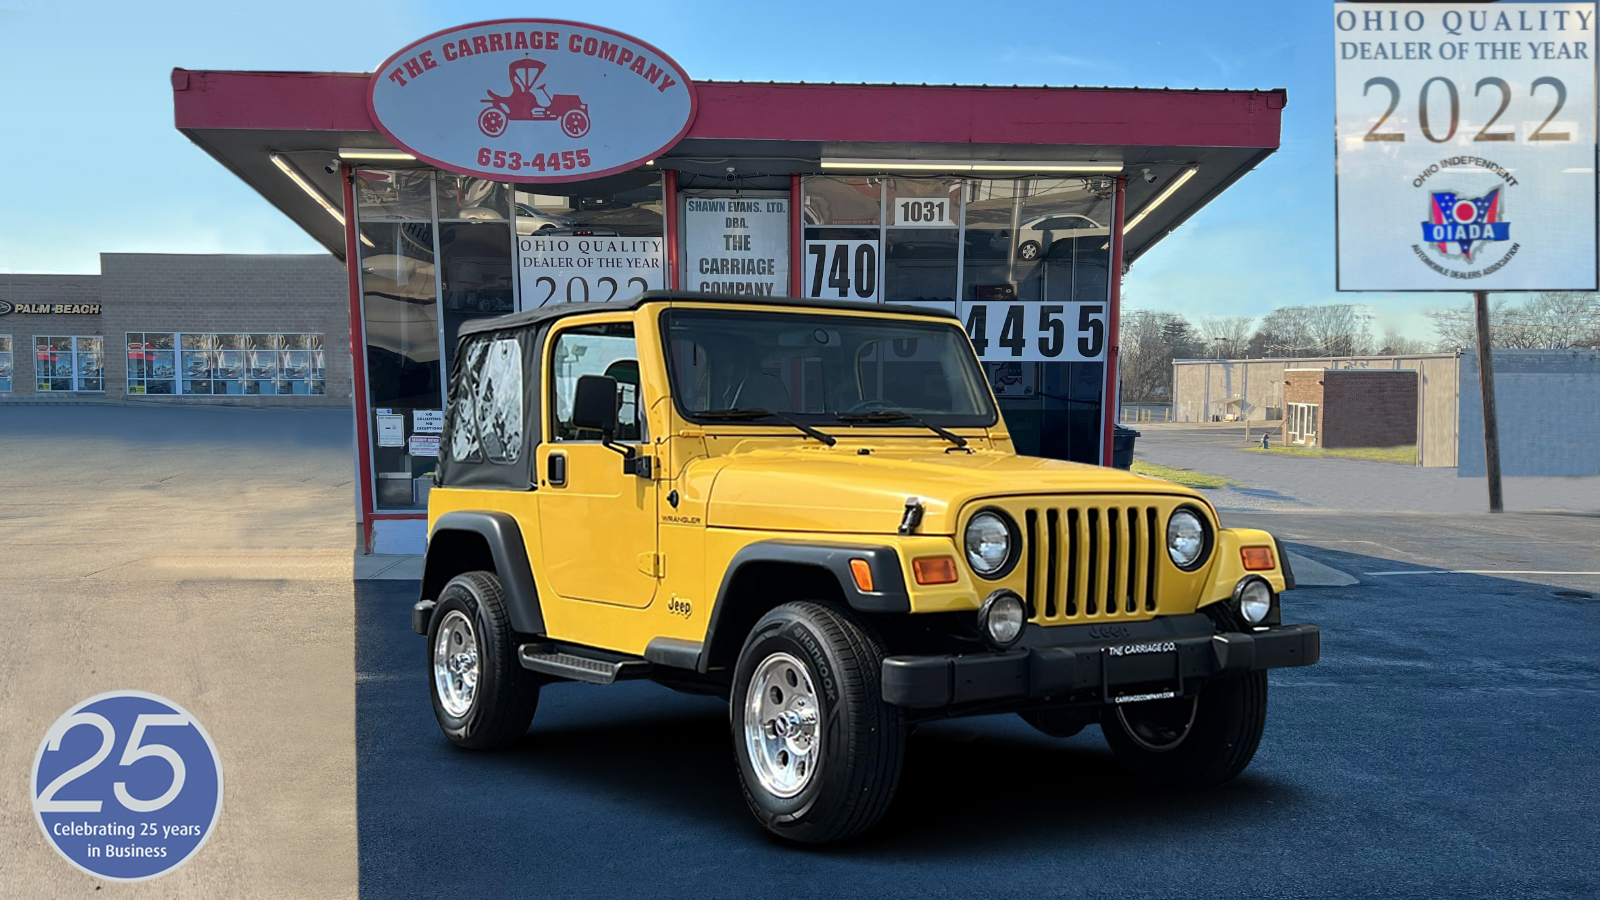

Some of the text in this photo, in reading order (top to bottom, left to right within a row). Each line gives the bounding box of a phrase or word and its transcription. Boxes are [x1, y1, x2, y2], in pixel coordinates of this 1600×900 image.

[1336, 10, 1593, 36] OHIO QUALITY
[1340, 41, 1589, 60] DEALER OF THE YEAR
[388, 31, 677, 94] THE CARRIAGE COMPANY
[1362, 76, 1571, 143] 2022
[477, 148, 592, 172] 653-4455
[1412, 155, 1519, 189] OHIO INDEPENDENT
[688, 201, 786, 213] SHAWN EVANS. LTD.
[901, 201, 945, 223] 1031
[725, 217, 749, 229] DBA.
[1433, 223, 1495, 241] OIADA
[520, 240, 662, 255] OHIO QUALITY
[723, 234, 751, 252] THE
[523, 256, 660, 269] DEALER OF THE YEAR
[699, 257, 775, 276] CARRIAGE
[1410, 241, 1521, 280] AUTOMOBILE DEALERS ASSOCIATION
[808, 243, 876, 299] 740
[700, 281, 774, 297] COMPANY
[15, 303, 100, 314] PALM BEACH
[963, 304, 1104, 359] 4455
[661, 515, 702, 524] WRANGLER
[668, 597, 691, 615] Jeep
[1088, 626, 1130, 639] Jeep
[1109, 641, 1177, 656] THE CARRIAGE CO.
[799, 632, 836, 701] Hankook
